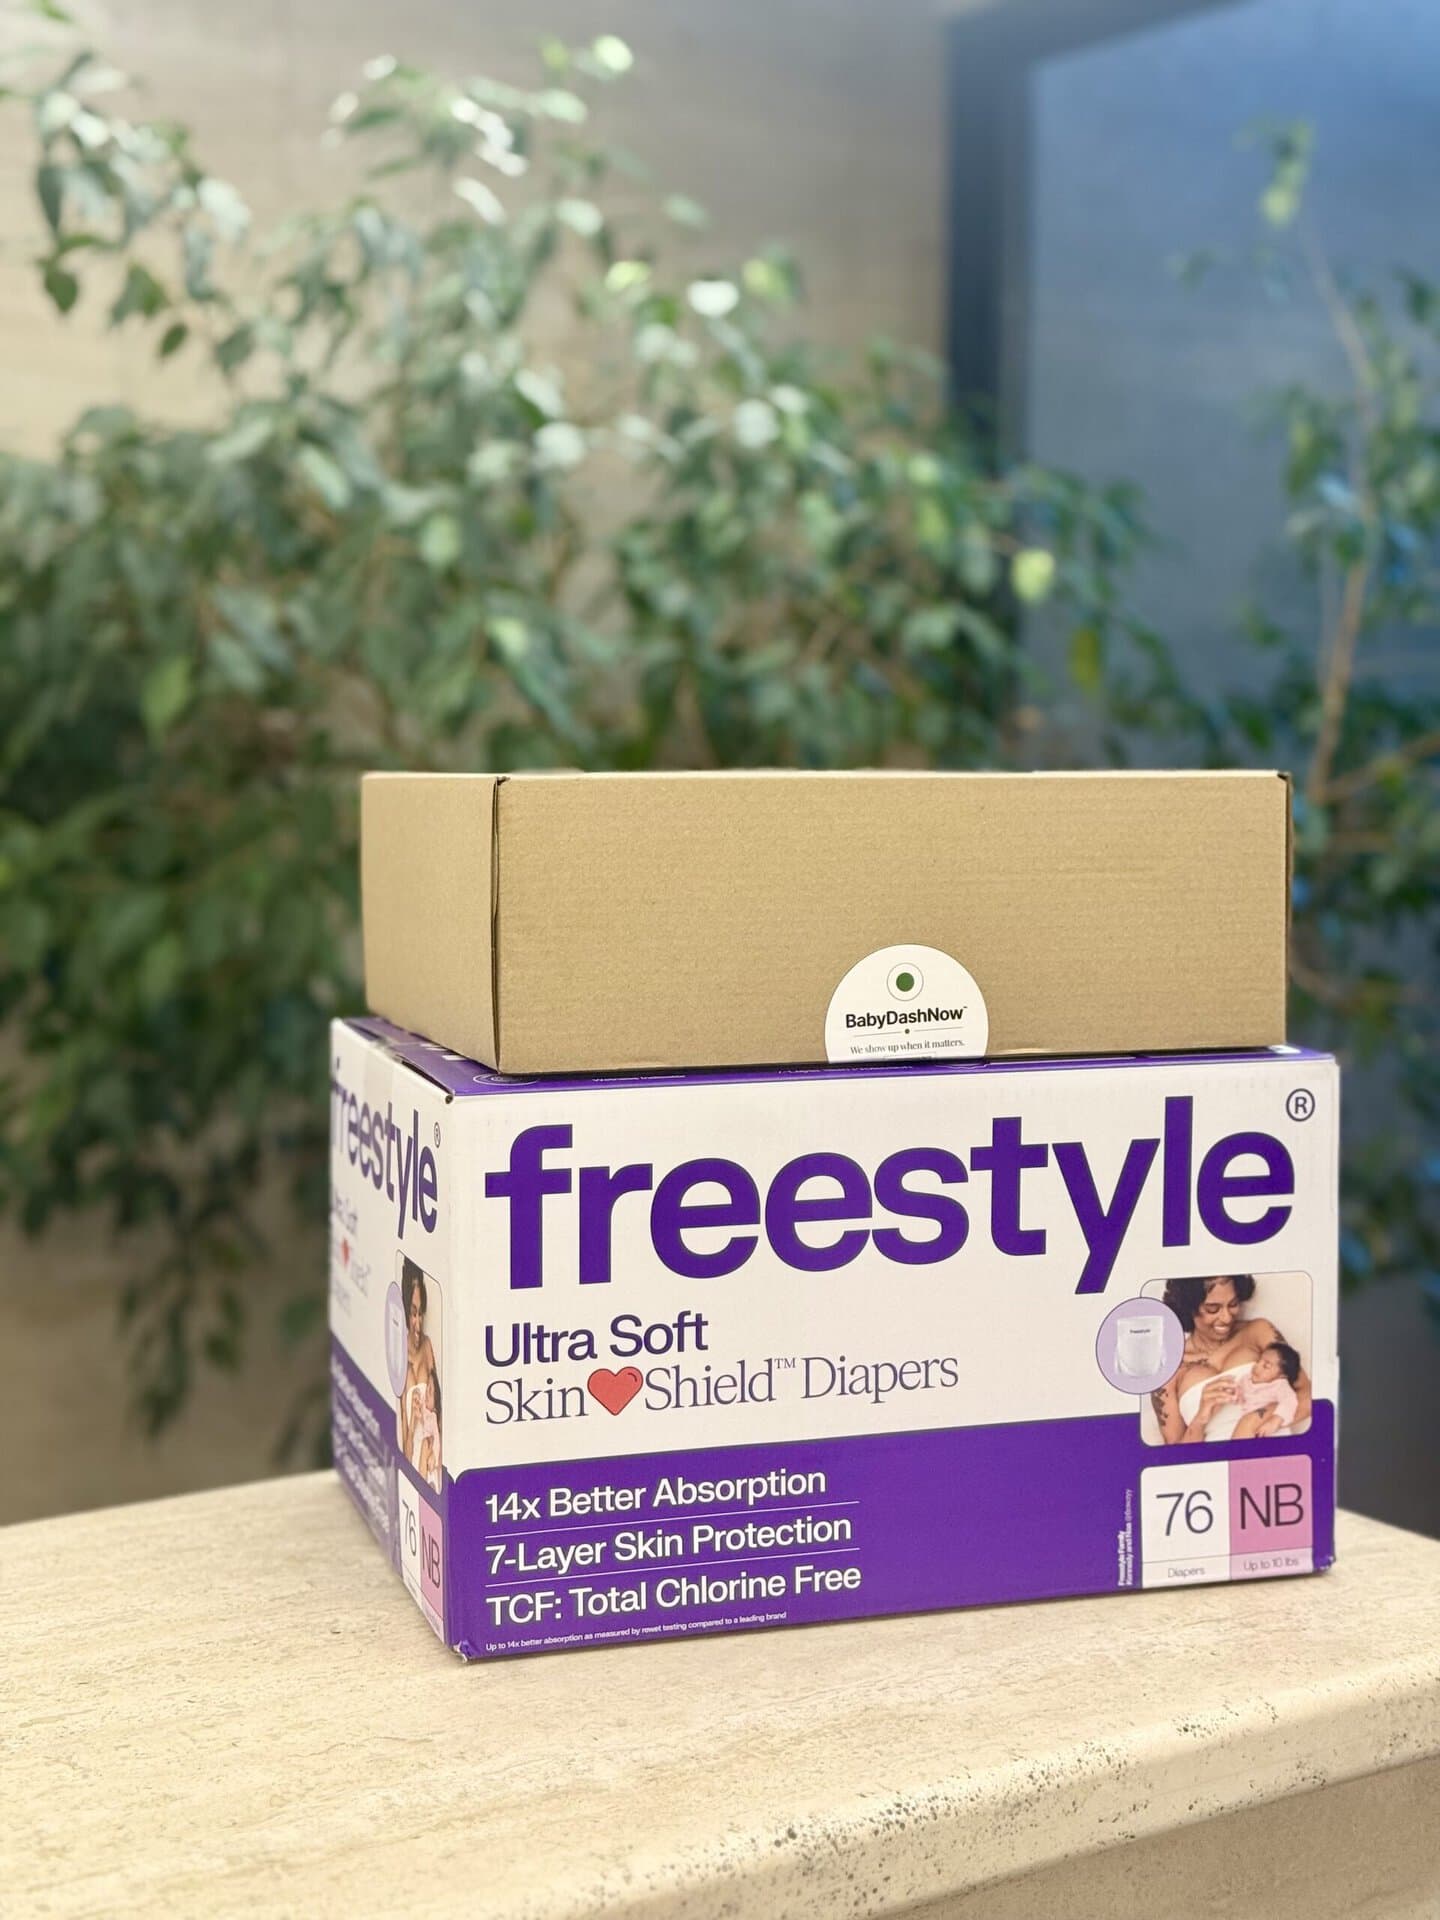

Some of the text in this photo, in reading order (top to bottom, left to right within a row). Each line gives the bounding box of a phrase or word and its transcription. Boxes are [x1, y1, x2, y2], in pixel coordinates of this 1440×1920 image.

[850, 1038, 965, 1055] We show up when it matters.
[485, 1310, 709, 1367] Ultra Soft
[485, 1378, 589, 1424] Skin
[801, 1354, 959, 1404] Diapers
[485, 1468, 827, 1523] 14x Better Absorption
[1156, 1489, 1214, 1537] 76
[1240, 1483, 1305, 1530] NB
[402, 1499, 417, 1557] 76
[485, 1515, 852, 1575] 7-Layer Skin Protection
[421, 1525, 441, 1588] NB
[1167, 1567, 1206, 1579] Diapers
[1243, 1556, 1300, 1572] Up to 10 lbs
[485, 1564, 862, 1626] TCF: Total Chlorine Free
[485, 1642, 497, 1651] Up
[521, 1638, 542, 1647] better
[543, 1634, 584, 1645] absorption
[594, 1628, 630, 1639] measured
[631, 1627, 641, 1636] by
[662, 1622, 687, 1631] testing
[688, 1618, 724, 1630] compared
[725, 1617, 733, 1625] to
[739, 1614, 765, 1624] leading
[766, 1612, 787, 1621] brand
